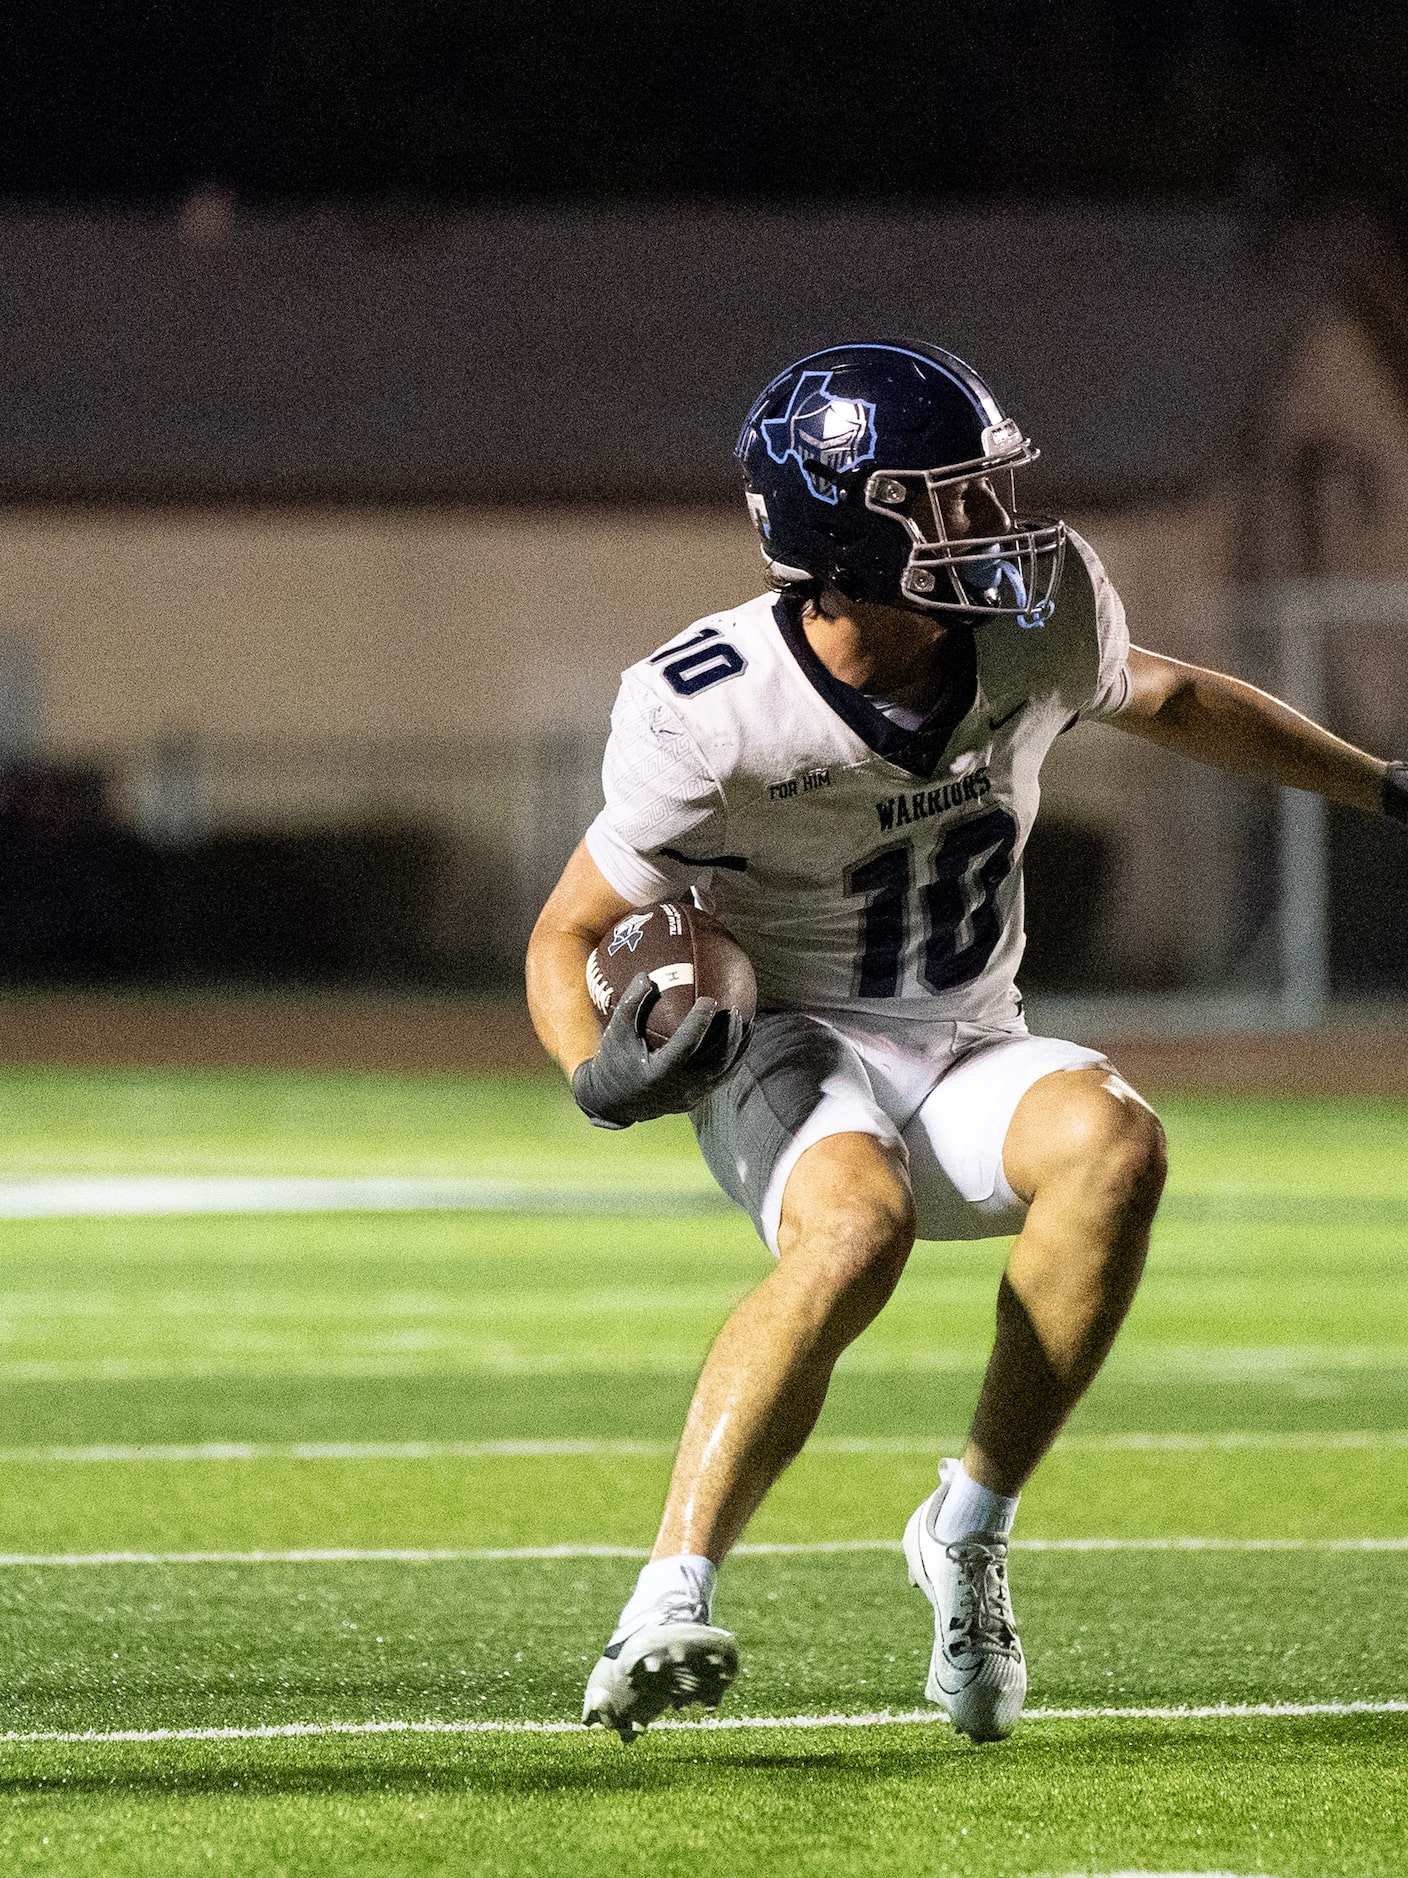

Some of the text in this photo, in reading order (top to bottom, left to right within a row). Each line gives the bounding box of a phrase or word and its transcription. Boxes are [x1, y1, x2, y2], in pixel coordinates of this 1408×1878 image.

[645, 626, 749, 700] 10
[769, 769, 832, 800] FOR HIM
[874, 766, 992, 832] WARRIORS
[843, 803, 1021, 998] 10
